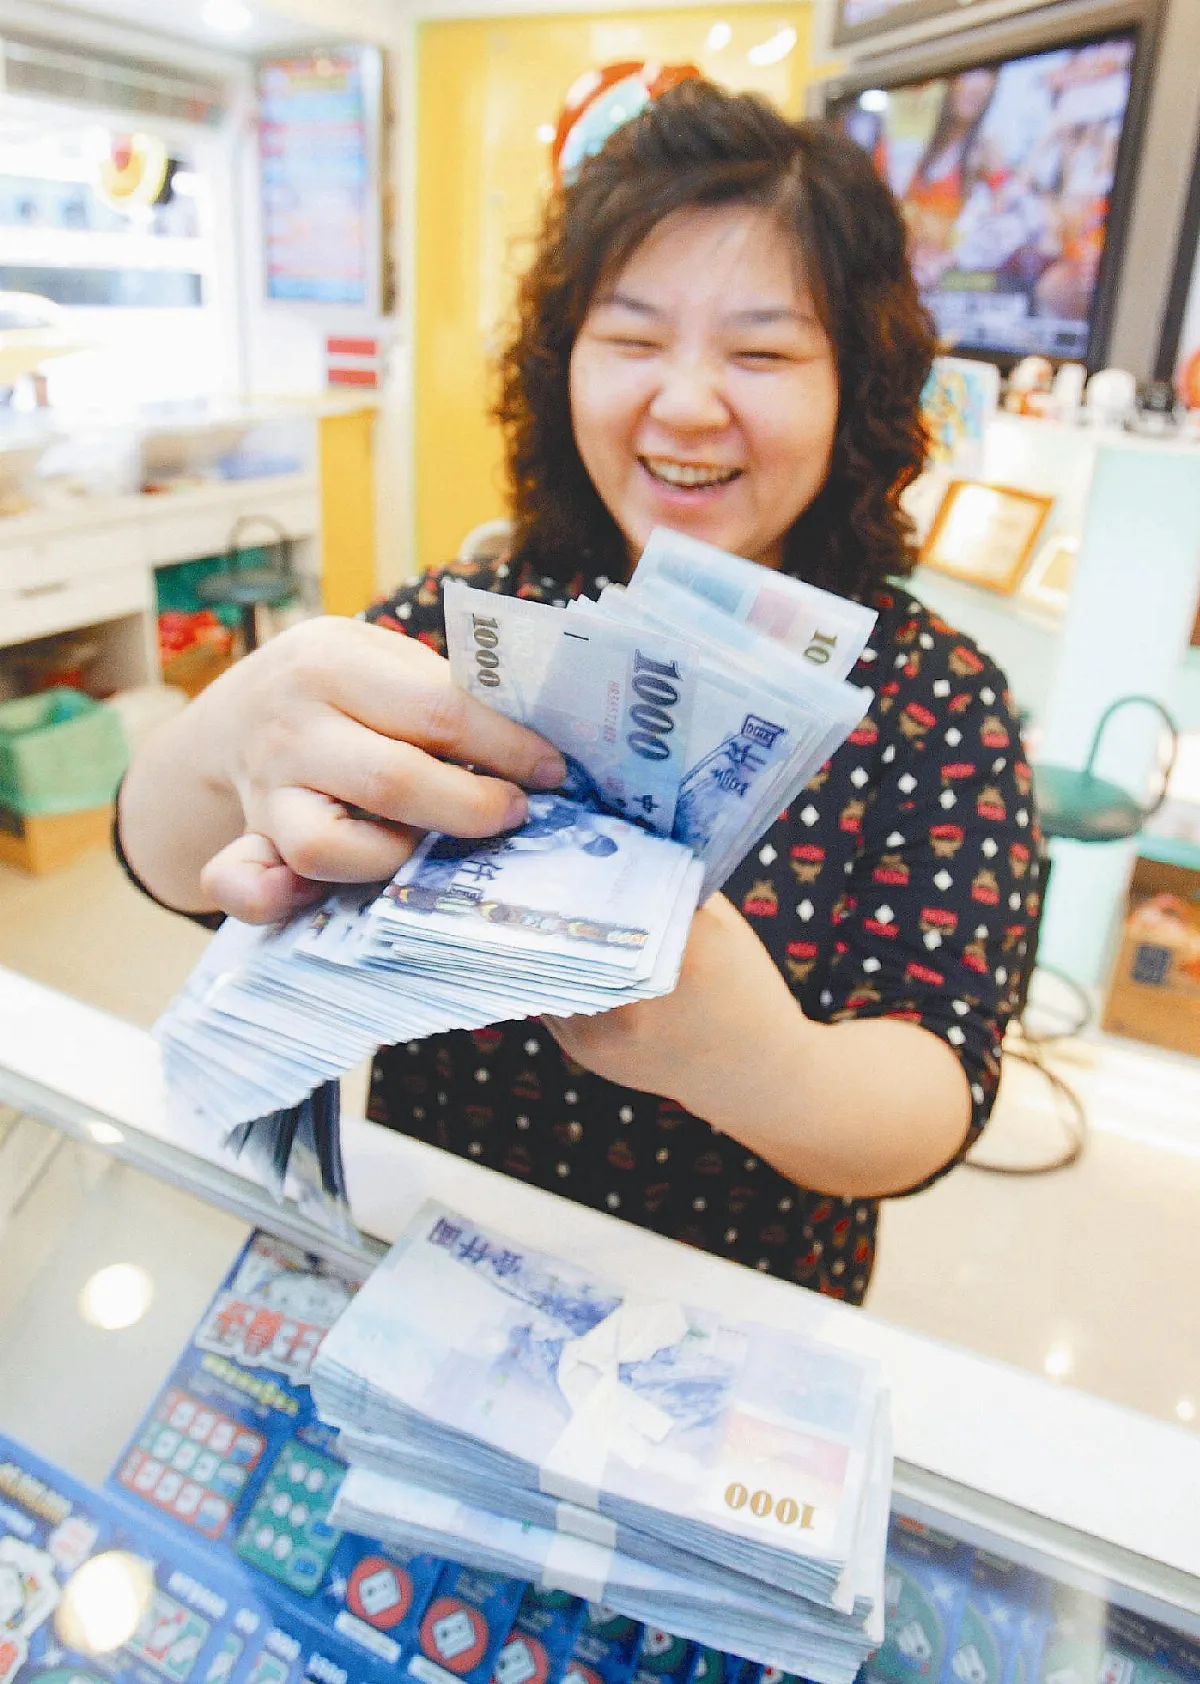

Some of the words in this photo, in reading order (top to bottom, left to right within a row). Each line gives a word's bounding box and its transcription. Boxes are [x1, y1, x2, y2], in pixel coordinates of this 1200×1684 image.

[472, 612, 500, 687] 1000
[626, 648, 683, 762] 1000
[724, 1482, 815, 1529] 1000
